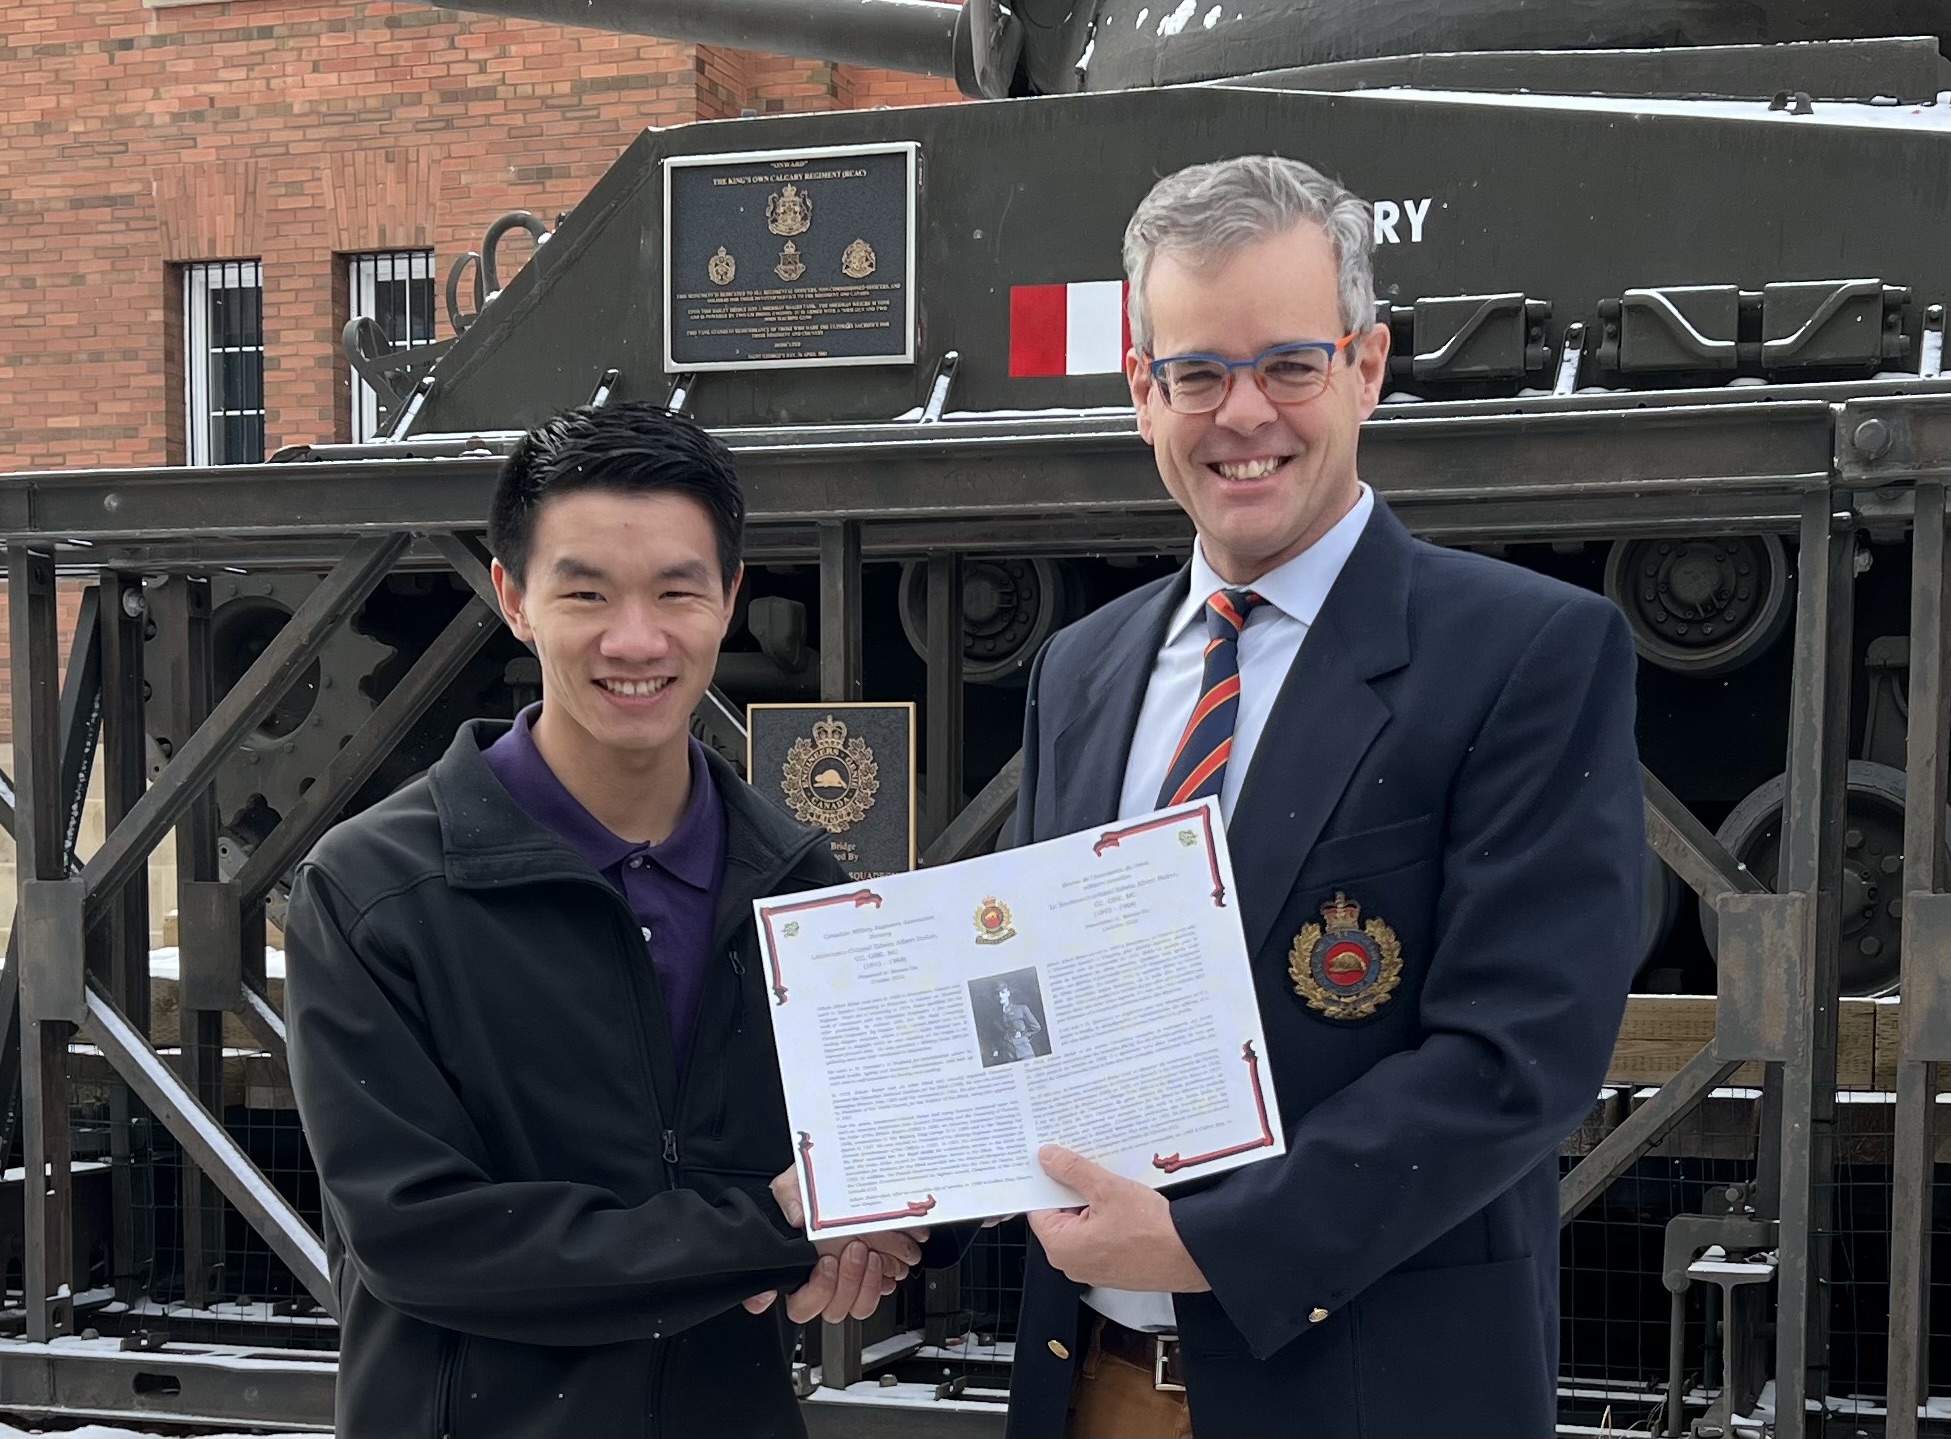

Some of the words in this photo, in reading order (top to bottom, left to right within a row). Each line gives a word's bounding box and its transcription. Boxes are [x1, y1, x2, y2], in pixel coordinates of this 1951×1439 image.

[713, 178, 727, 186] THE
[770, 174, 804, 182] CALGARY
[805, 172, 841, 180] REGIMENT
[1373, 198, 1432, 244] RY
[802, 747, 840, 788] ENGINEERS
[812, 797, 850, 810] CANADA
[830, 841, 856, 852] Bridge
[848, 852, 859, 862] By
[849, 871, 897, 881] SQUAD
